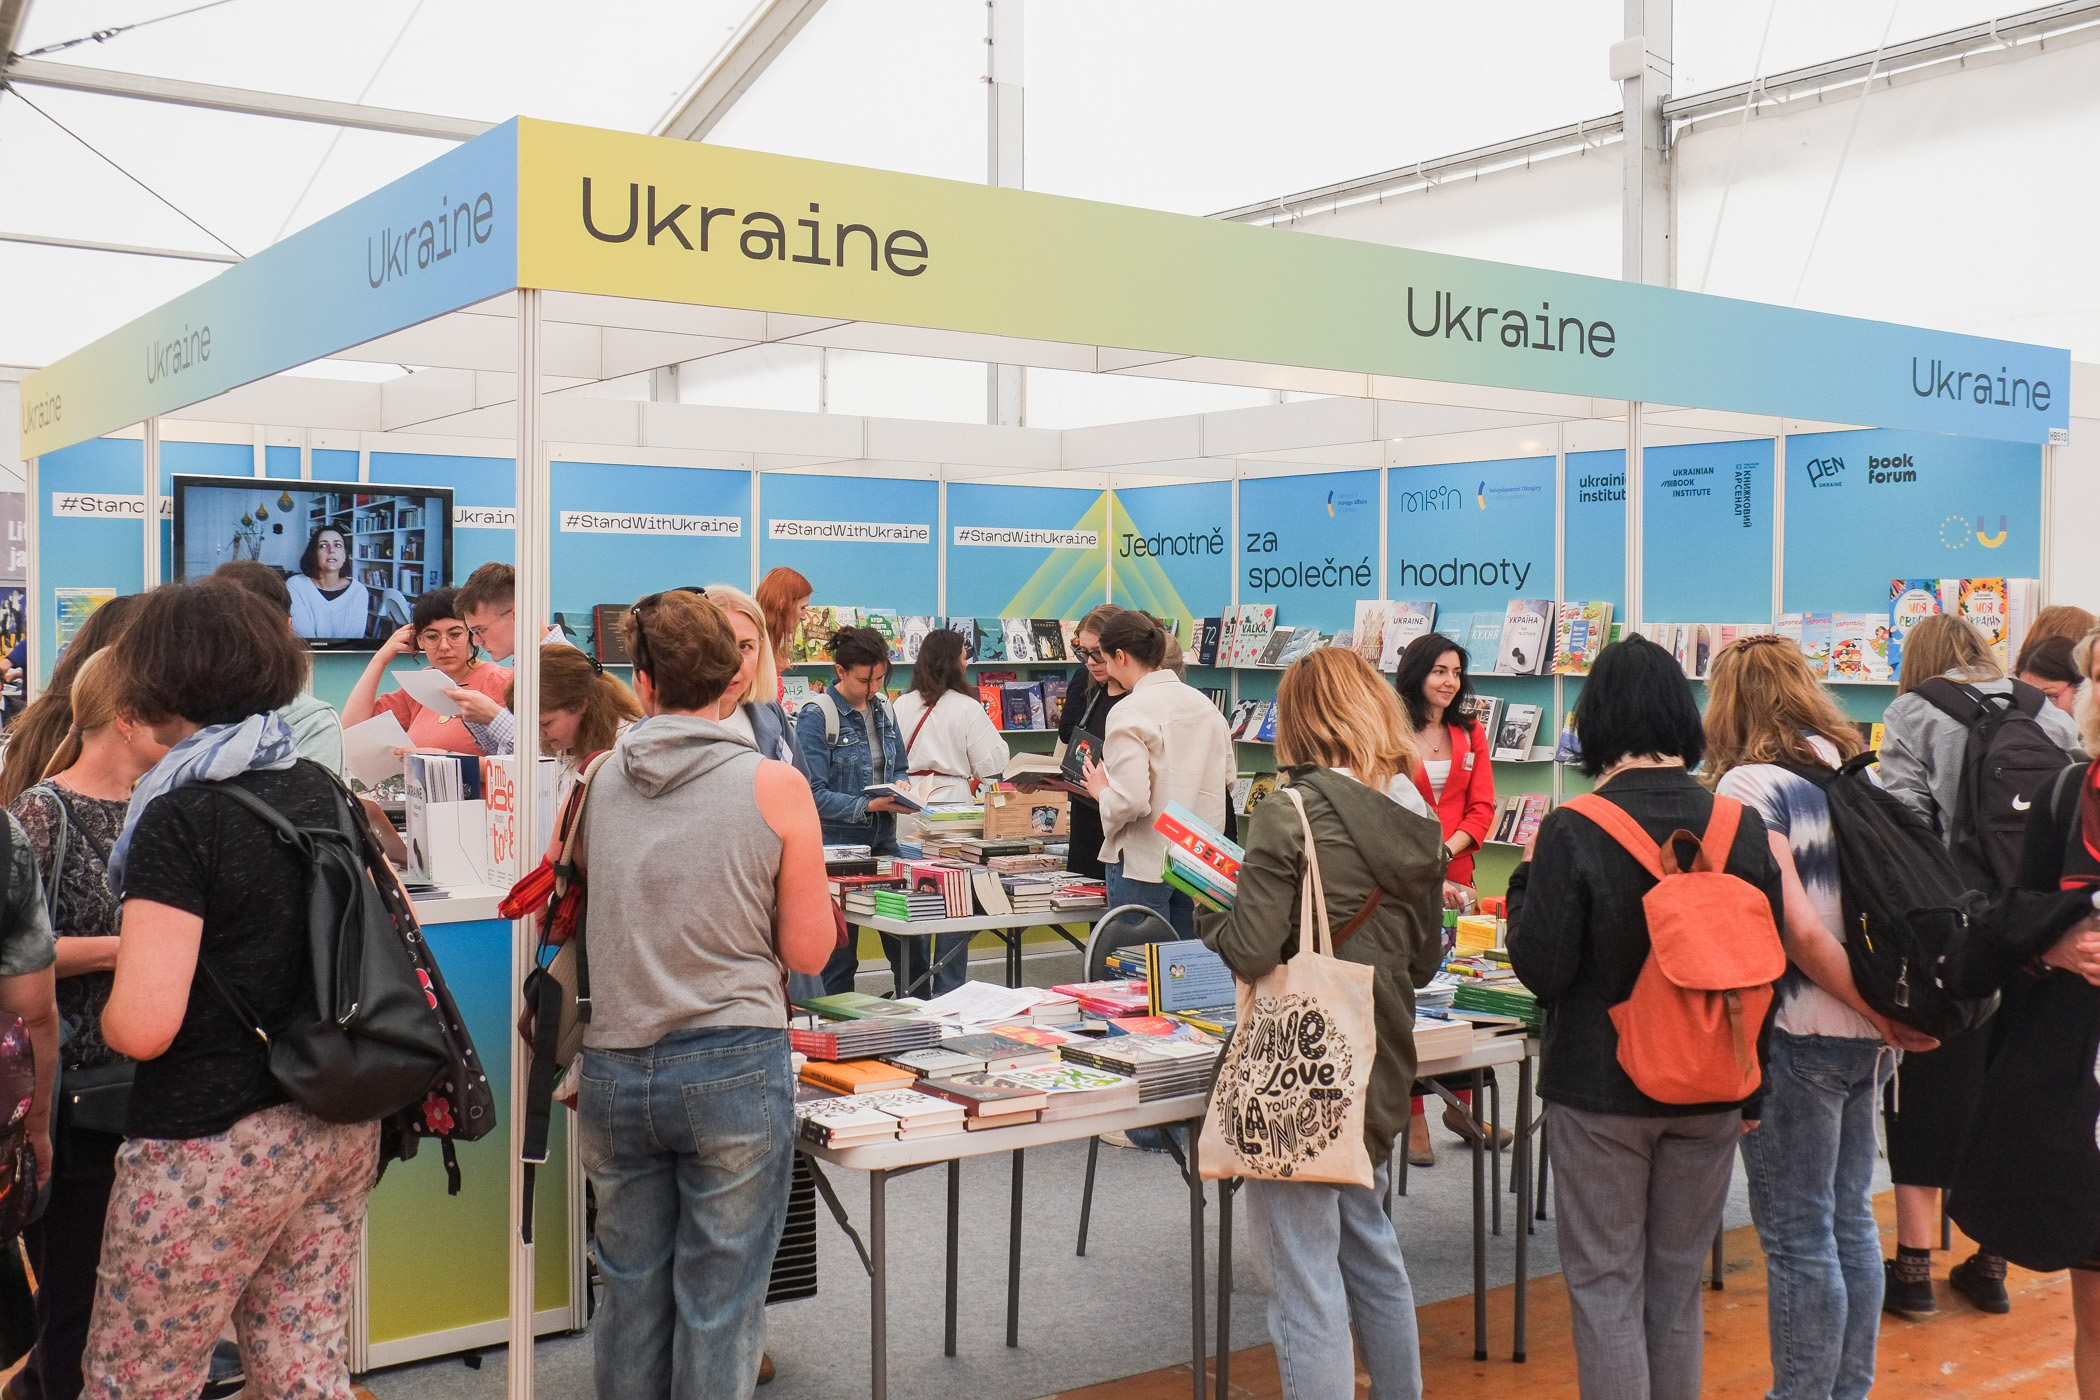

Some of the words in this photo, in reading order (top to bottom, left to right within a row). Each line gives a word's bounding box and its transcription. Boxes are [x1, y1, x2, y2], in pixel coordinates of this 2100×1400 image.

[582, 176, 929, 278] Ukraine
[368, 191, 494, 289] Ukraine
[1407, 286, 1616, 359] Ukraine
[146, 324, 211, 384] Ukraine
[1912, 356, 2051, 412] Ukraine
[22, 391, 62, 434] Ukraine
[2049, 431, 2067, 442] HB513
[1868, 453, 1914, 470] book
[1579, 472, 1627, 488] ukraini
[1672, 467, 1715, 477] UKRAINIAN
[1868, 469, 1917, 485] forum
[1672, 478, 1695, 487] BOOK
[1579, 489, 1627, 503] institut
[1672, 488, 1712, 498] INSTITUTE
[1734, 471, 1743, 516] АРСЕНАЛ
[1743, 470, 1752, 528] КНИЖКОВИЙ
[565, 513, 739, 533] #StandWithUkraine
[773, 522, 928, 540] #StandWithUkraine
[958, 529, 1097, 546] #StandWithUkraine
[1119, 526, 1224, 558] Jednotně
[1246, 531, 1278, 553] za
[1248, 556, 1372, 594] společné
[1400, 557, 1532, 591] hodnoty
[1393, 617, 1424, 625] UKRAINE
[1509, 615, 1538, 624] УКРАЇНА
[1204, 626, 1217, 644] 72
[1264, 1096, 1298, 1113] YOUR
